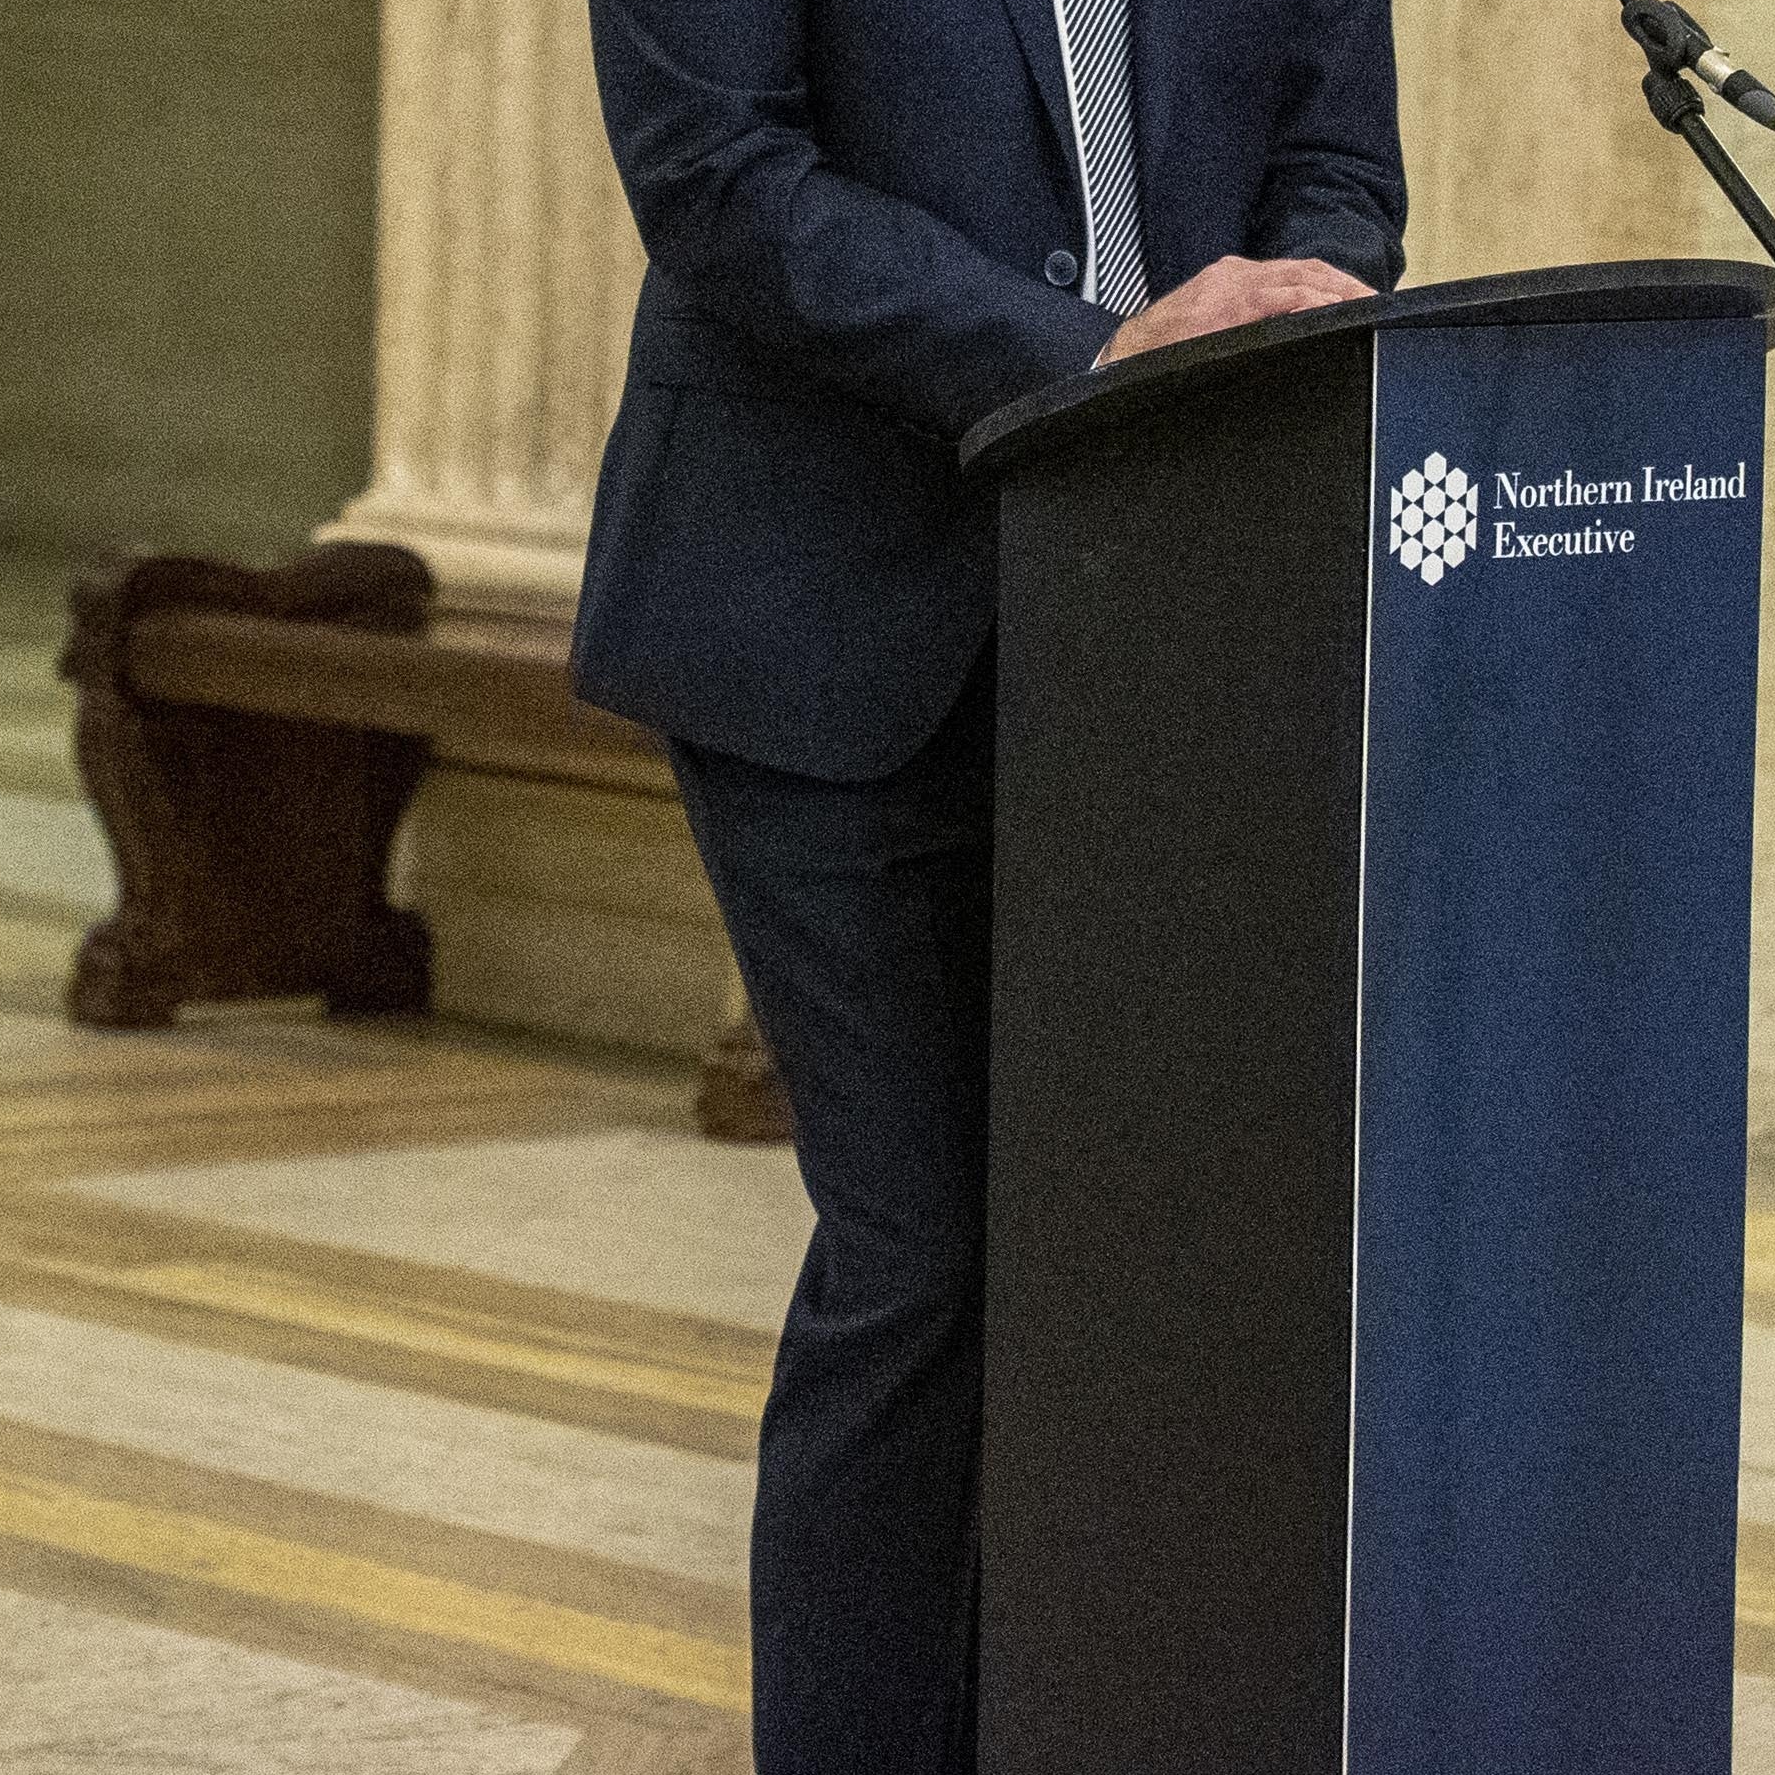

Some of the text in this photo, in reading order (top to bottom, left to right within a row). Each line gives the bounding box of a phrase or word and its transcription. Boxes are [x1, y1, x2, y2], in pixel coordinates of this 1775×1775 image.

[1493, 461, 1747, 509] Northern Ireland
[1492, 519, 1636, 559] Executive
